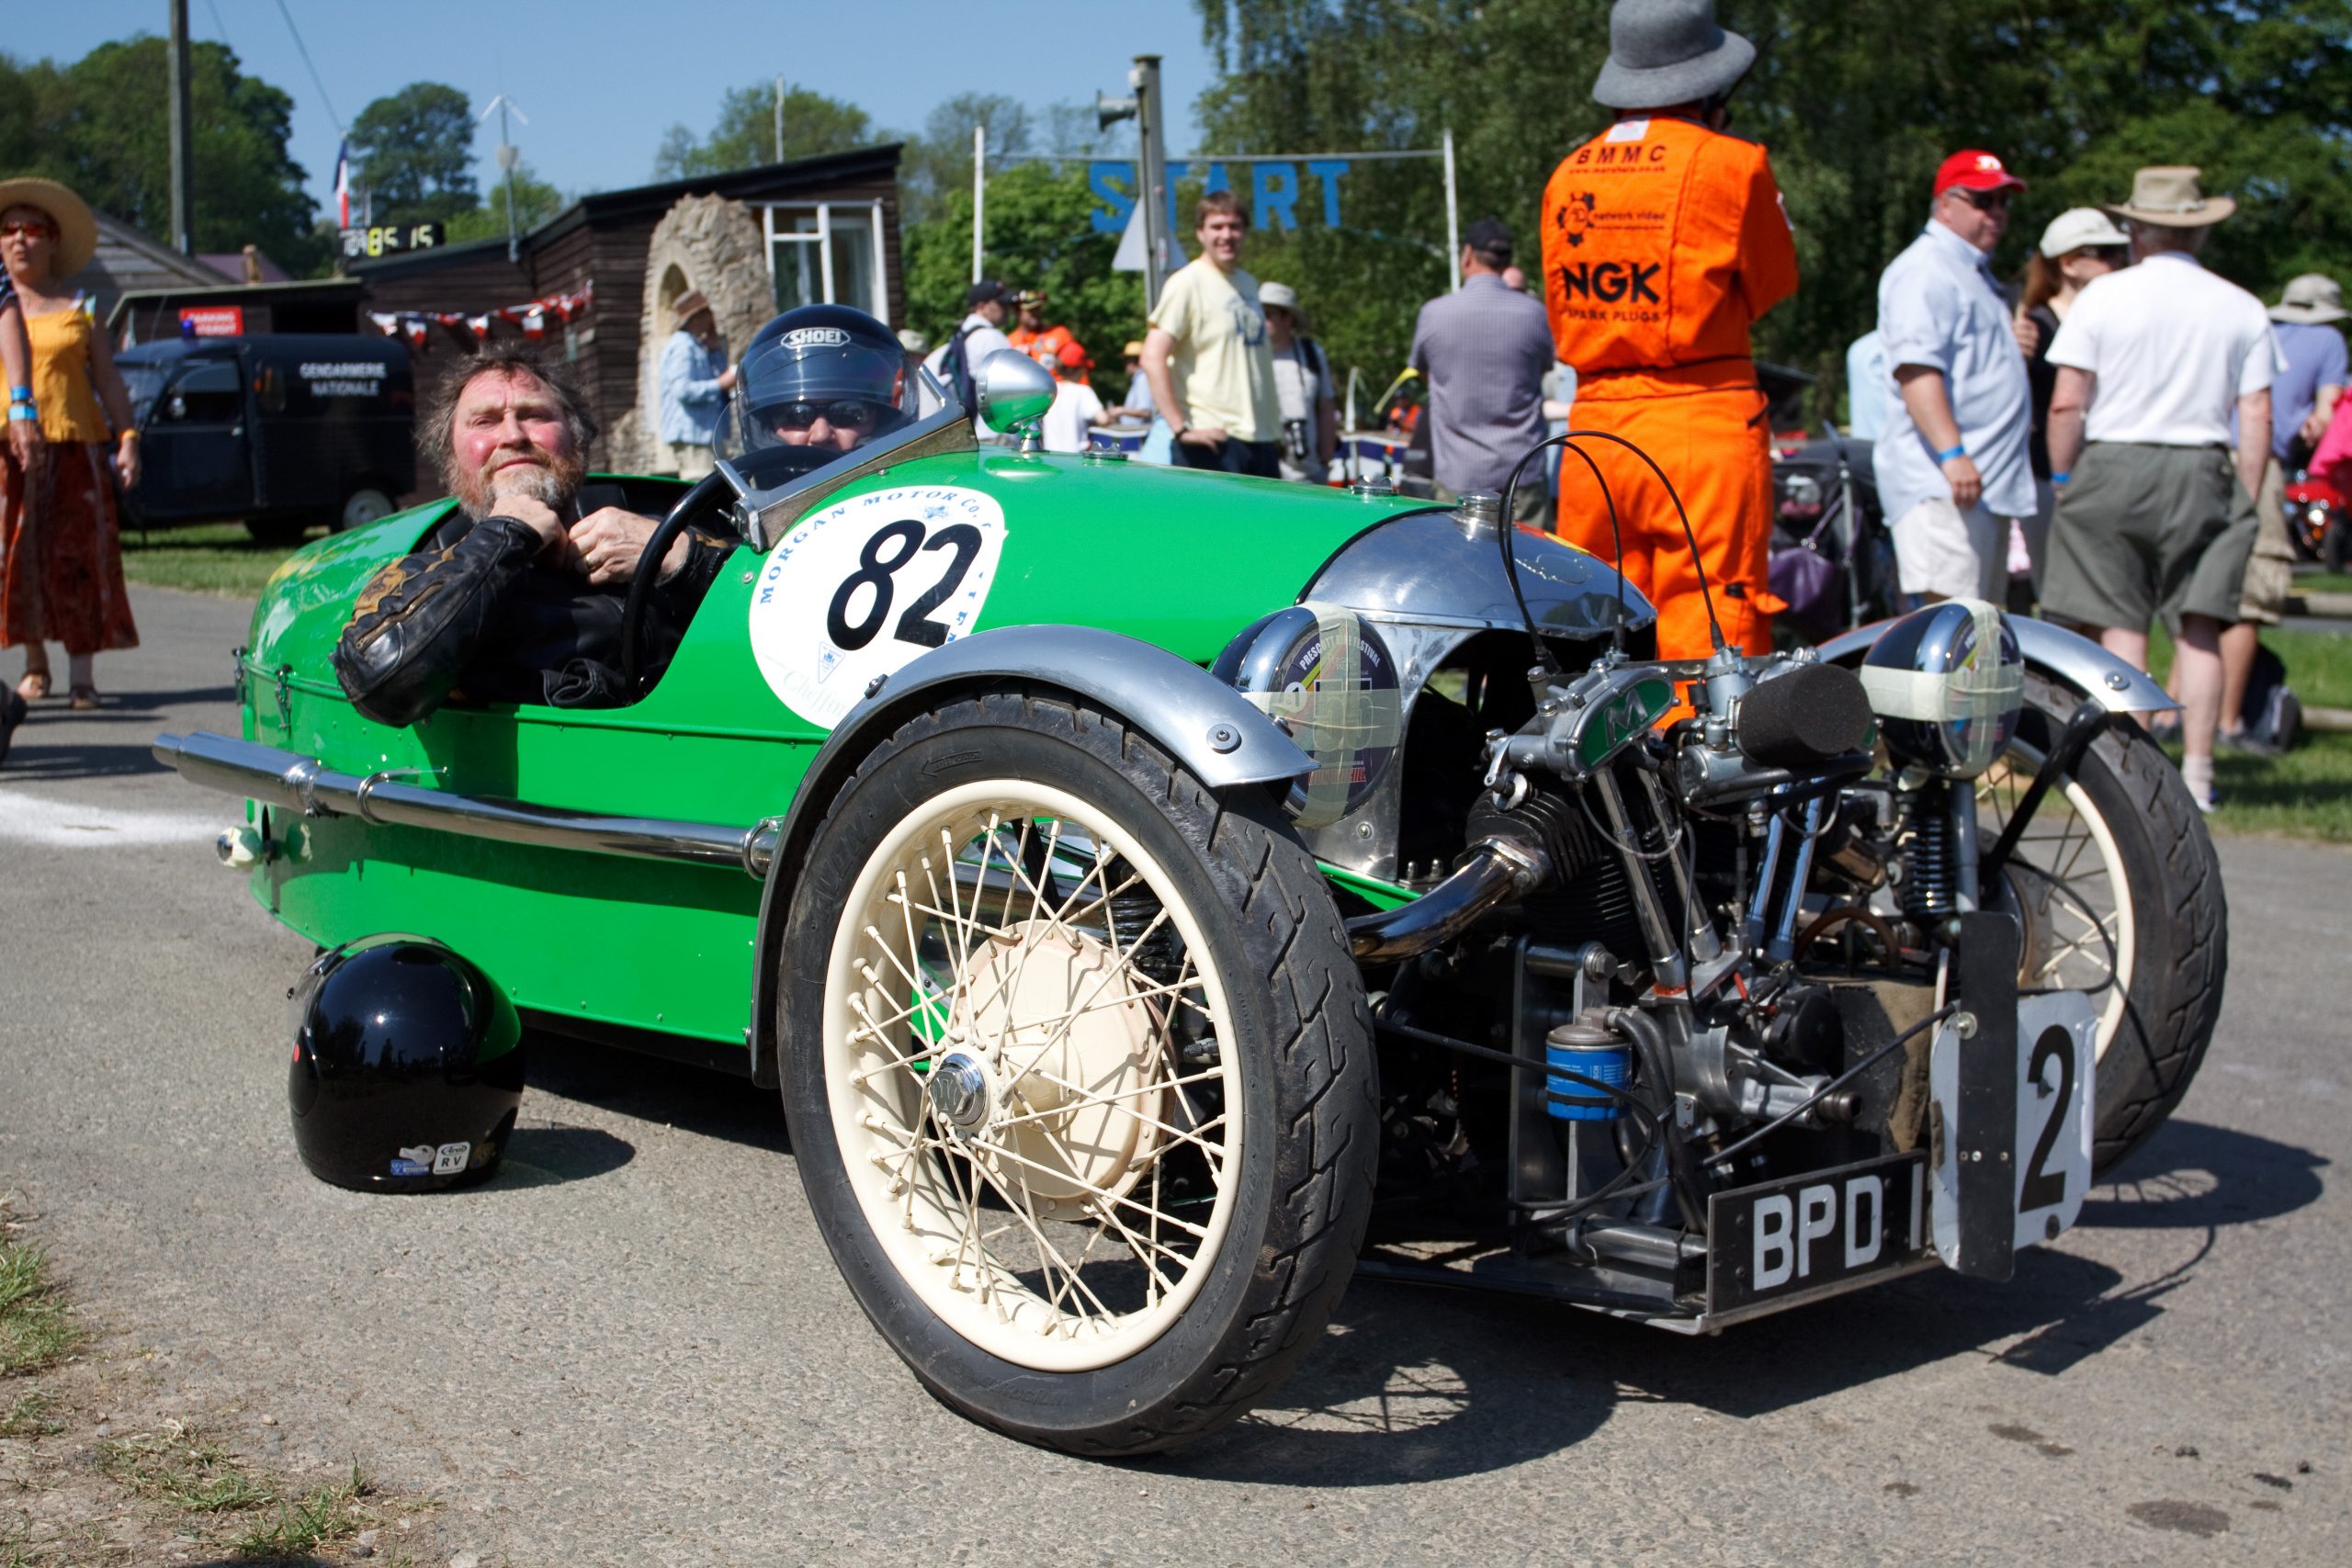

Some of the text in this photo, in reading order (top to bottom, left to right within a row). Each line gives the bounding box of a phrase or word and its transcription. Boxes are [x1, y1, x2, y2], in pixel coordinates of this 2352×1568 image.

[1561, 261, 1661, 304] NGK
[1613, 311, 1660, 322] PLUGS
[789, 329, 842, 345] SHOEI
[300, 362, 388, 378] GENDARMERIE
[311, 380, 379, 396] NATIONALE
[759, 506, 847, 604] MORGAN
[863, 490, 958, 507] MOTOR
[827, 518, 983, 651] 82
[1299, 636, 1335, 671] PRESCOTT
[1753, 1175, 1883, 1292] BPD
